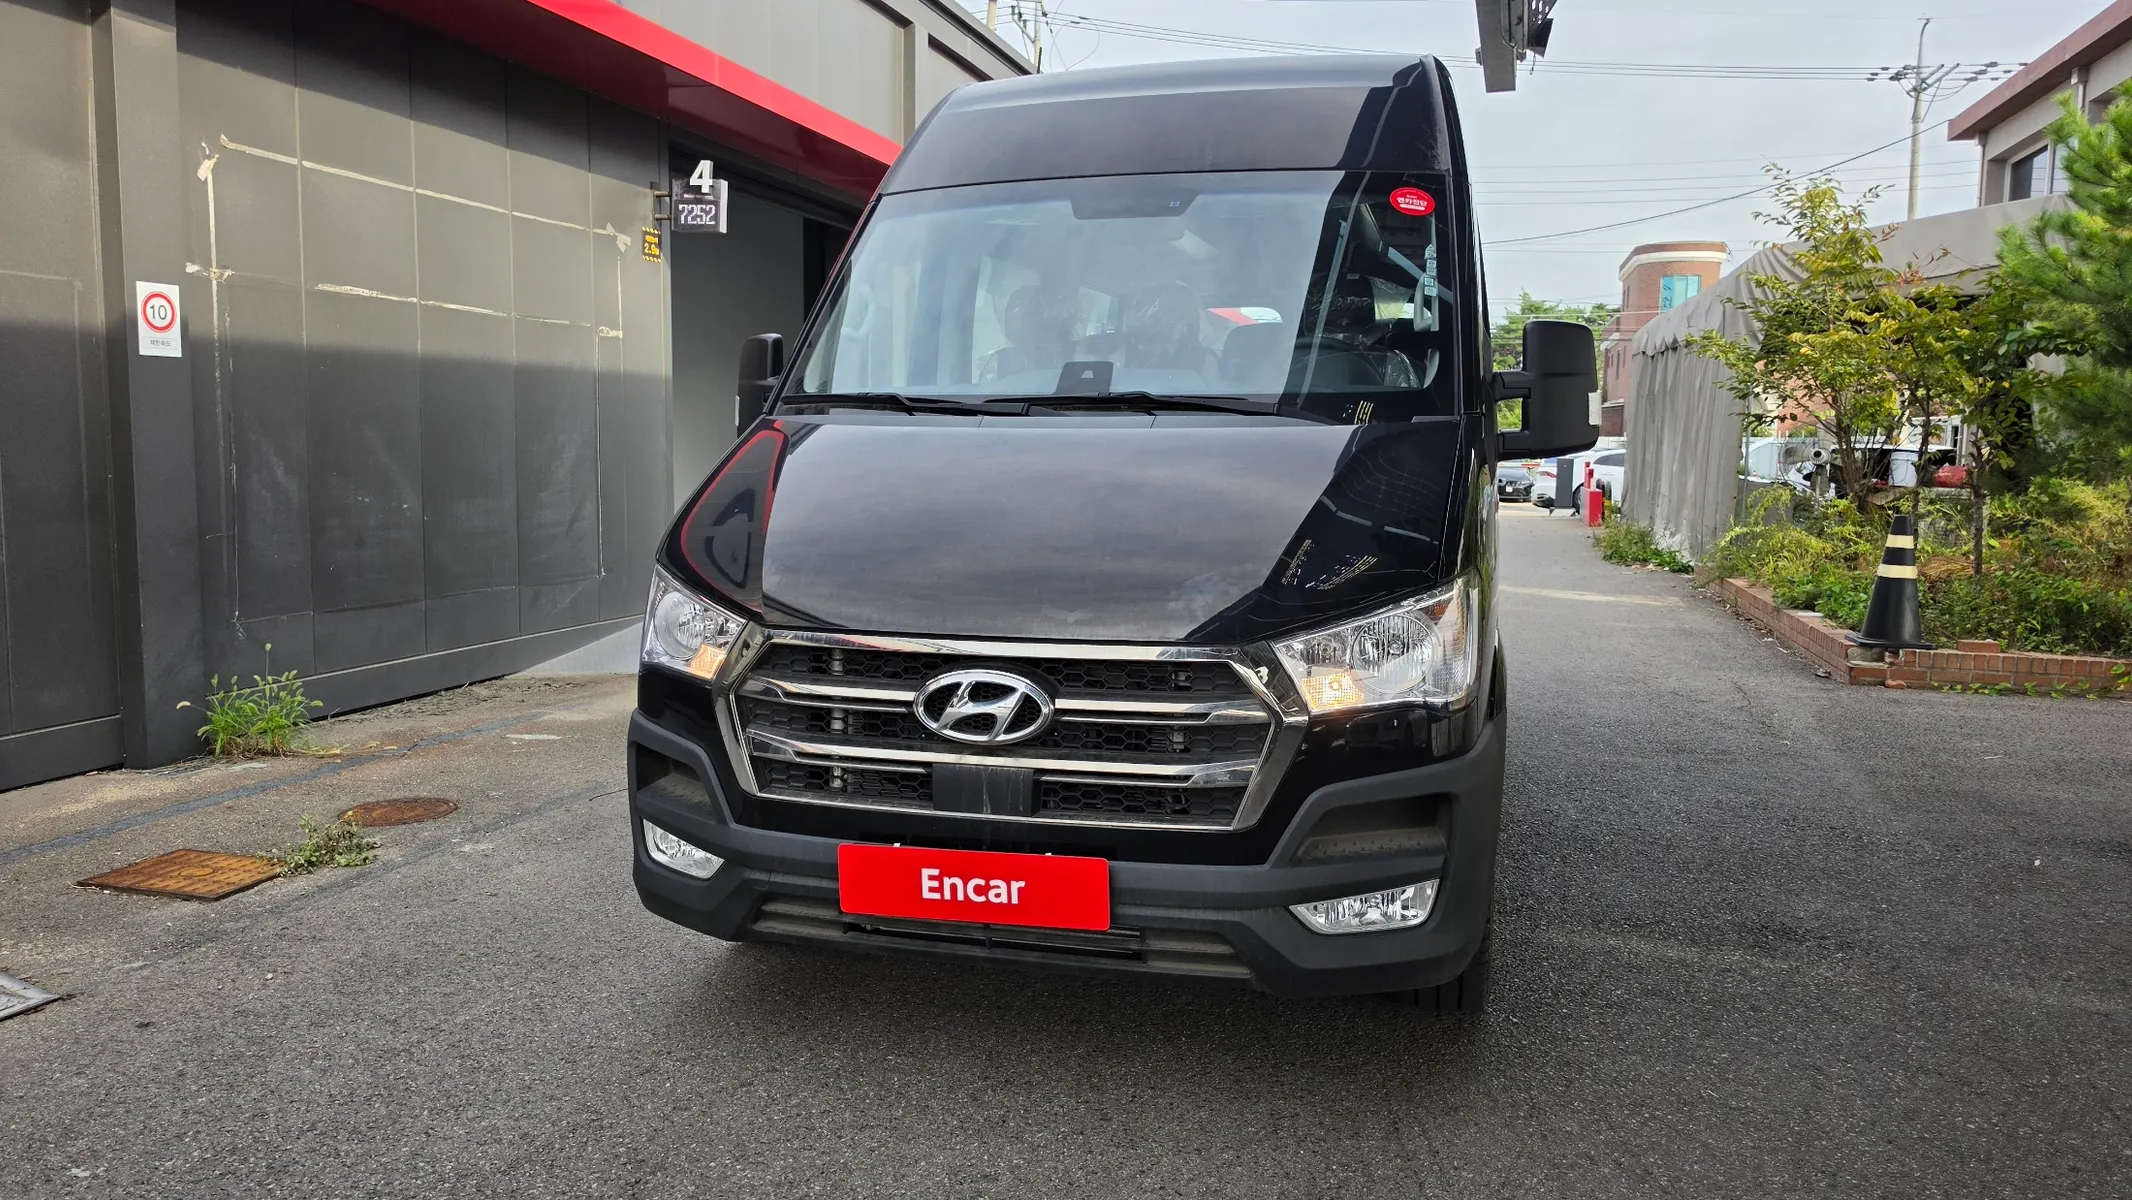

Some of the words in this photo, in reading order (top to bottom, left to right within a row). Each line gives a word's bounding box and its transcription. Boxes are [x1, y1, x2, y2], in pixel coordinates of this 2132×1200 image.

[690, 160, 713, 193] 4
[679, 204, 716, 224] 7252
[150, 304, 167, 320] 10
[922, 868, 1026, 904] Encar
